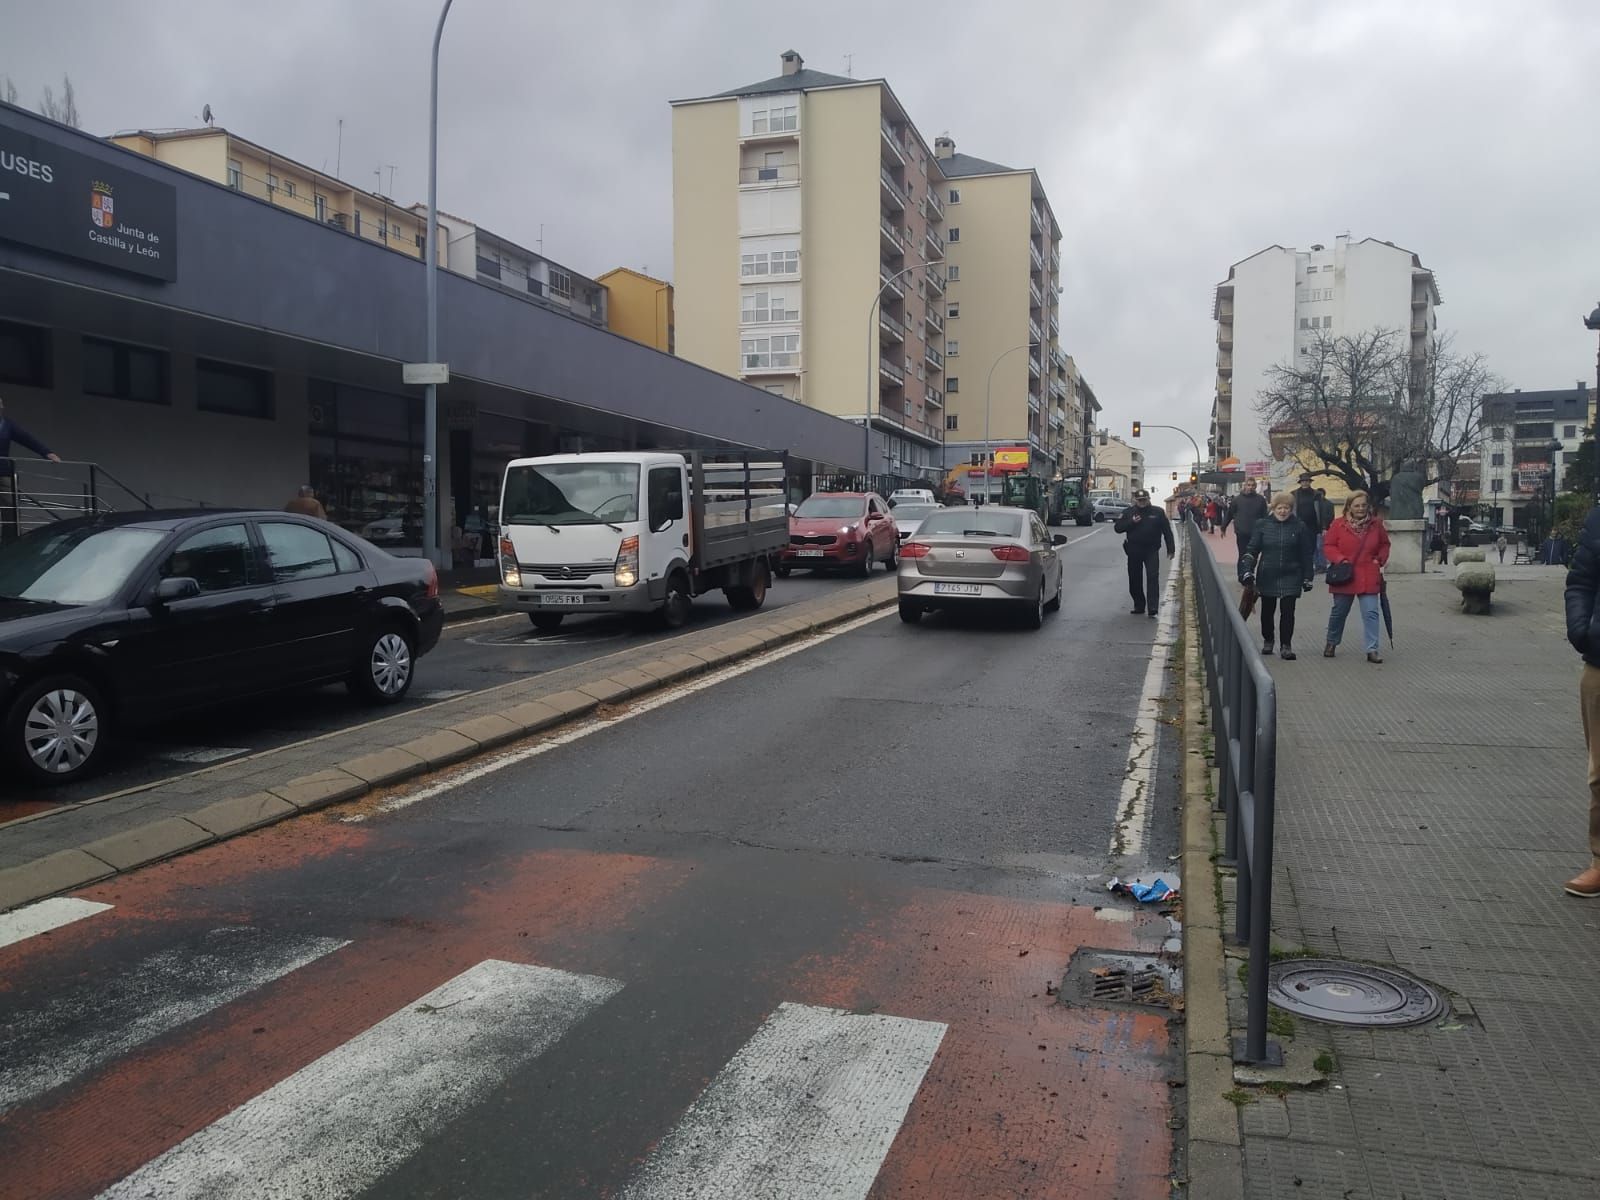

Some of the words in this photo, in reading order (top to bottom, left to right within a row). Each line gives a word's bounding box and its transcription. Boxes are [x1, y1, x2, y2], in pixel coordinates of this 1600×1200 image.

[1, 150, 53, 183] USES
[89, 230, 126, 249] Castilla
[128, 244, 134, 254] y
[136, 243, 160, 259] León
[117, 223, 145, 239] Junta
[147, 232, 160, 243] de
